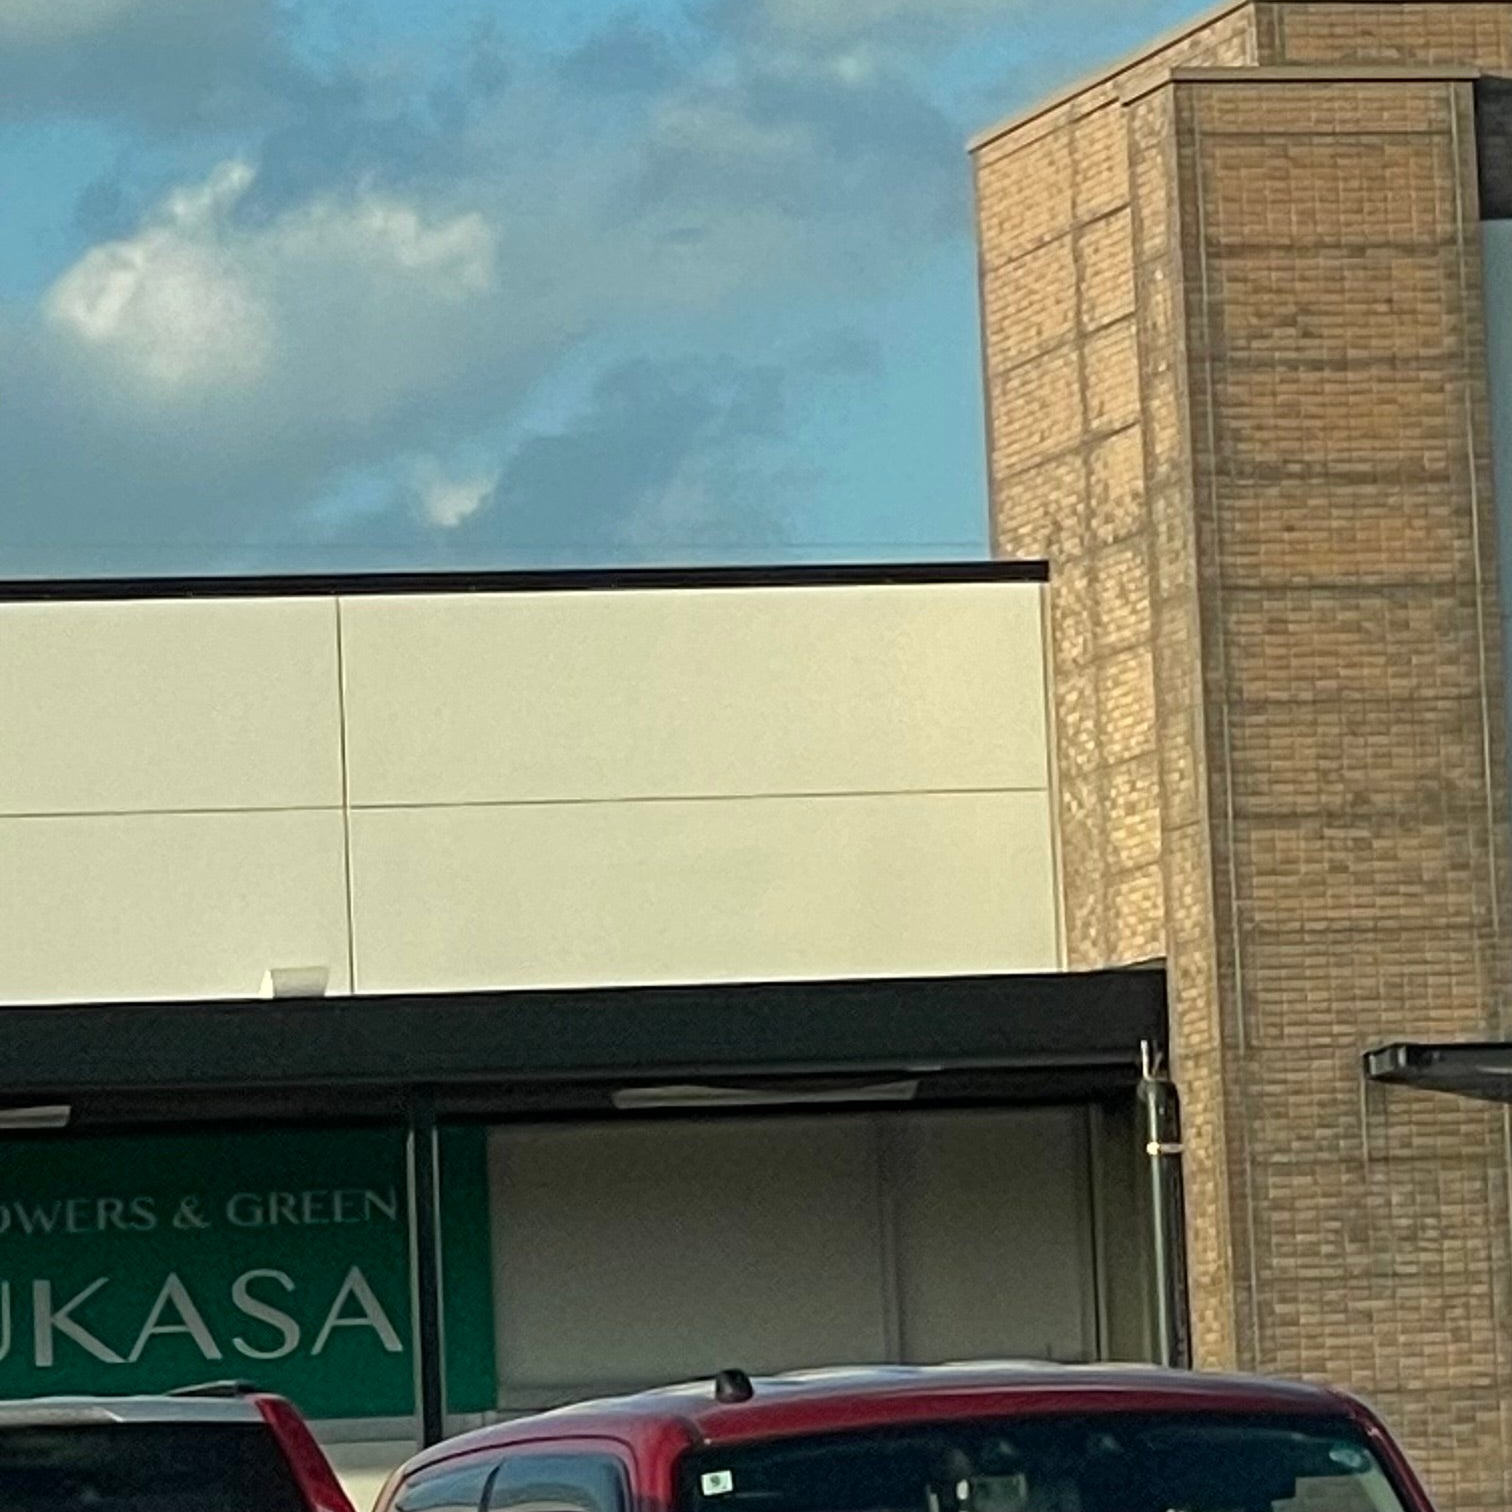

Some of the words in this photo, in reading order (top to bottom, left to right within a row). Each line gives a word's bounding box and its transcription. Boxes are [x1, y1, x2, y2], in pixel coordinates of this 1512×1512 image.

[172, 1194, 212, 1230] &
[225, 1187, 398, 1227] GREEN
[0, 1264, 404, 1368] KASA
